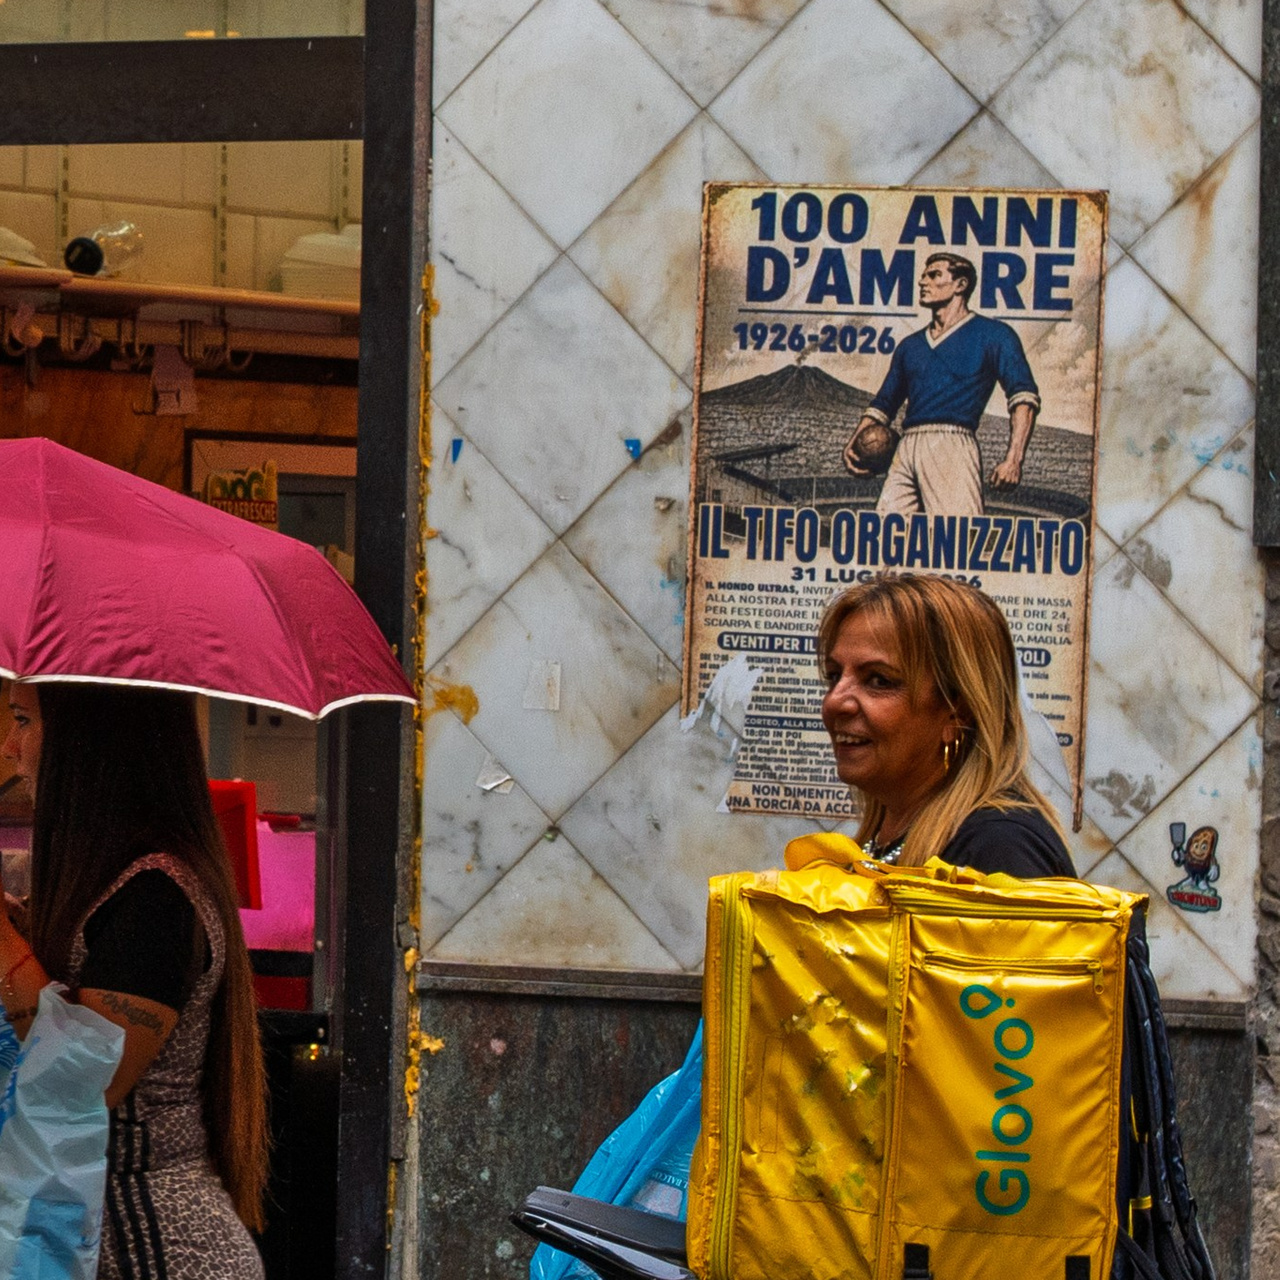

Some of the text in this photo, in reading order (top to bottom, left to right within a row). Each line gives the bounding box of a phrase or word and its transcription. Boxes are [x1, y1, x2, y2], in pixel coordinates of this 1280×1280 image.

[751, 192, 1079, 249] 100 ANNI
[733, 322, 896, 355] 1926-2026
[699, 504, 1086, 576] IL TIFO ORGANIZZATO
[791, 567, 816, 582] 31
[705, 581, 714, 590] IL
[718, 581, 755, 591] MONDO
[758, 583, 799, 595] ULTRAS,
[803, 586, 834, 595] INVITA
[1023, 597, 1034, 606] IN
[1037, 597, 1072, 608] MASSA
[706, 593, 735, 603] ALLA
[740, 595, 787, 606] NOSTRA
[791, 597, 826, 608] FESTA
[1023, 609, 1047, 619] ORE
[704, 618, 752, 629] SCIARPA
[754, 620, 761, 629] E
[705, 605, 727, 615] PER
[731, 606, 808, 619] FESTEGGIARE
[1027, 622, 1053, 632] CON
[723, 634, 770, 649] EVENTI
[774, 637, 800, 651] PER
[804, 639, 816, 652] IL
[782, 720, 804, 728] ALLA
[786, 731, 802, 739] POI
[752, 784, 780, 796] NON
[754, 798, 800, 811] TORCIA
[804, 801, 822, 812] DA
[974, 1017, 1035, 1217] Glovo
